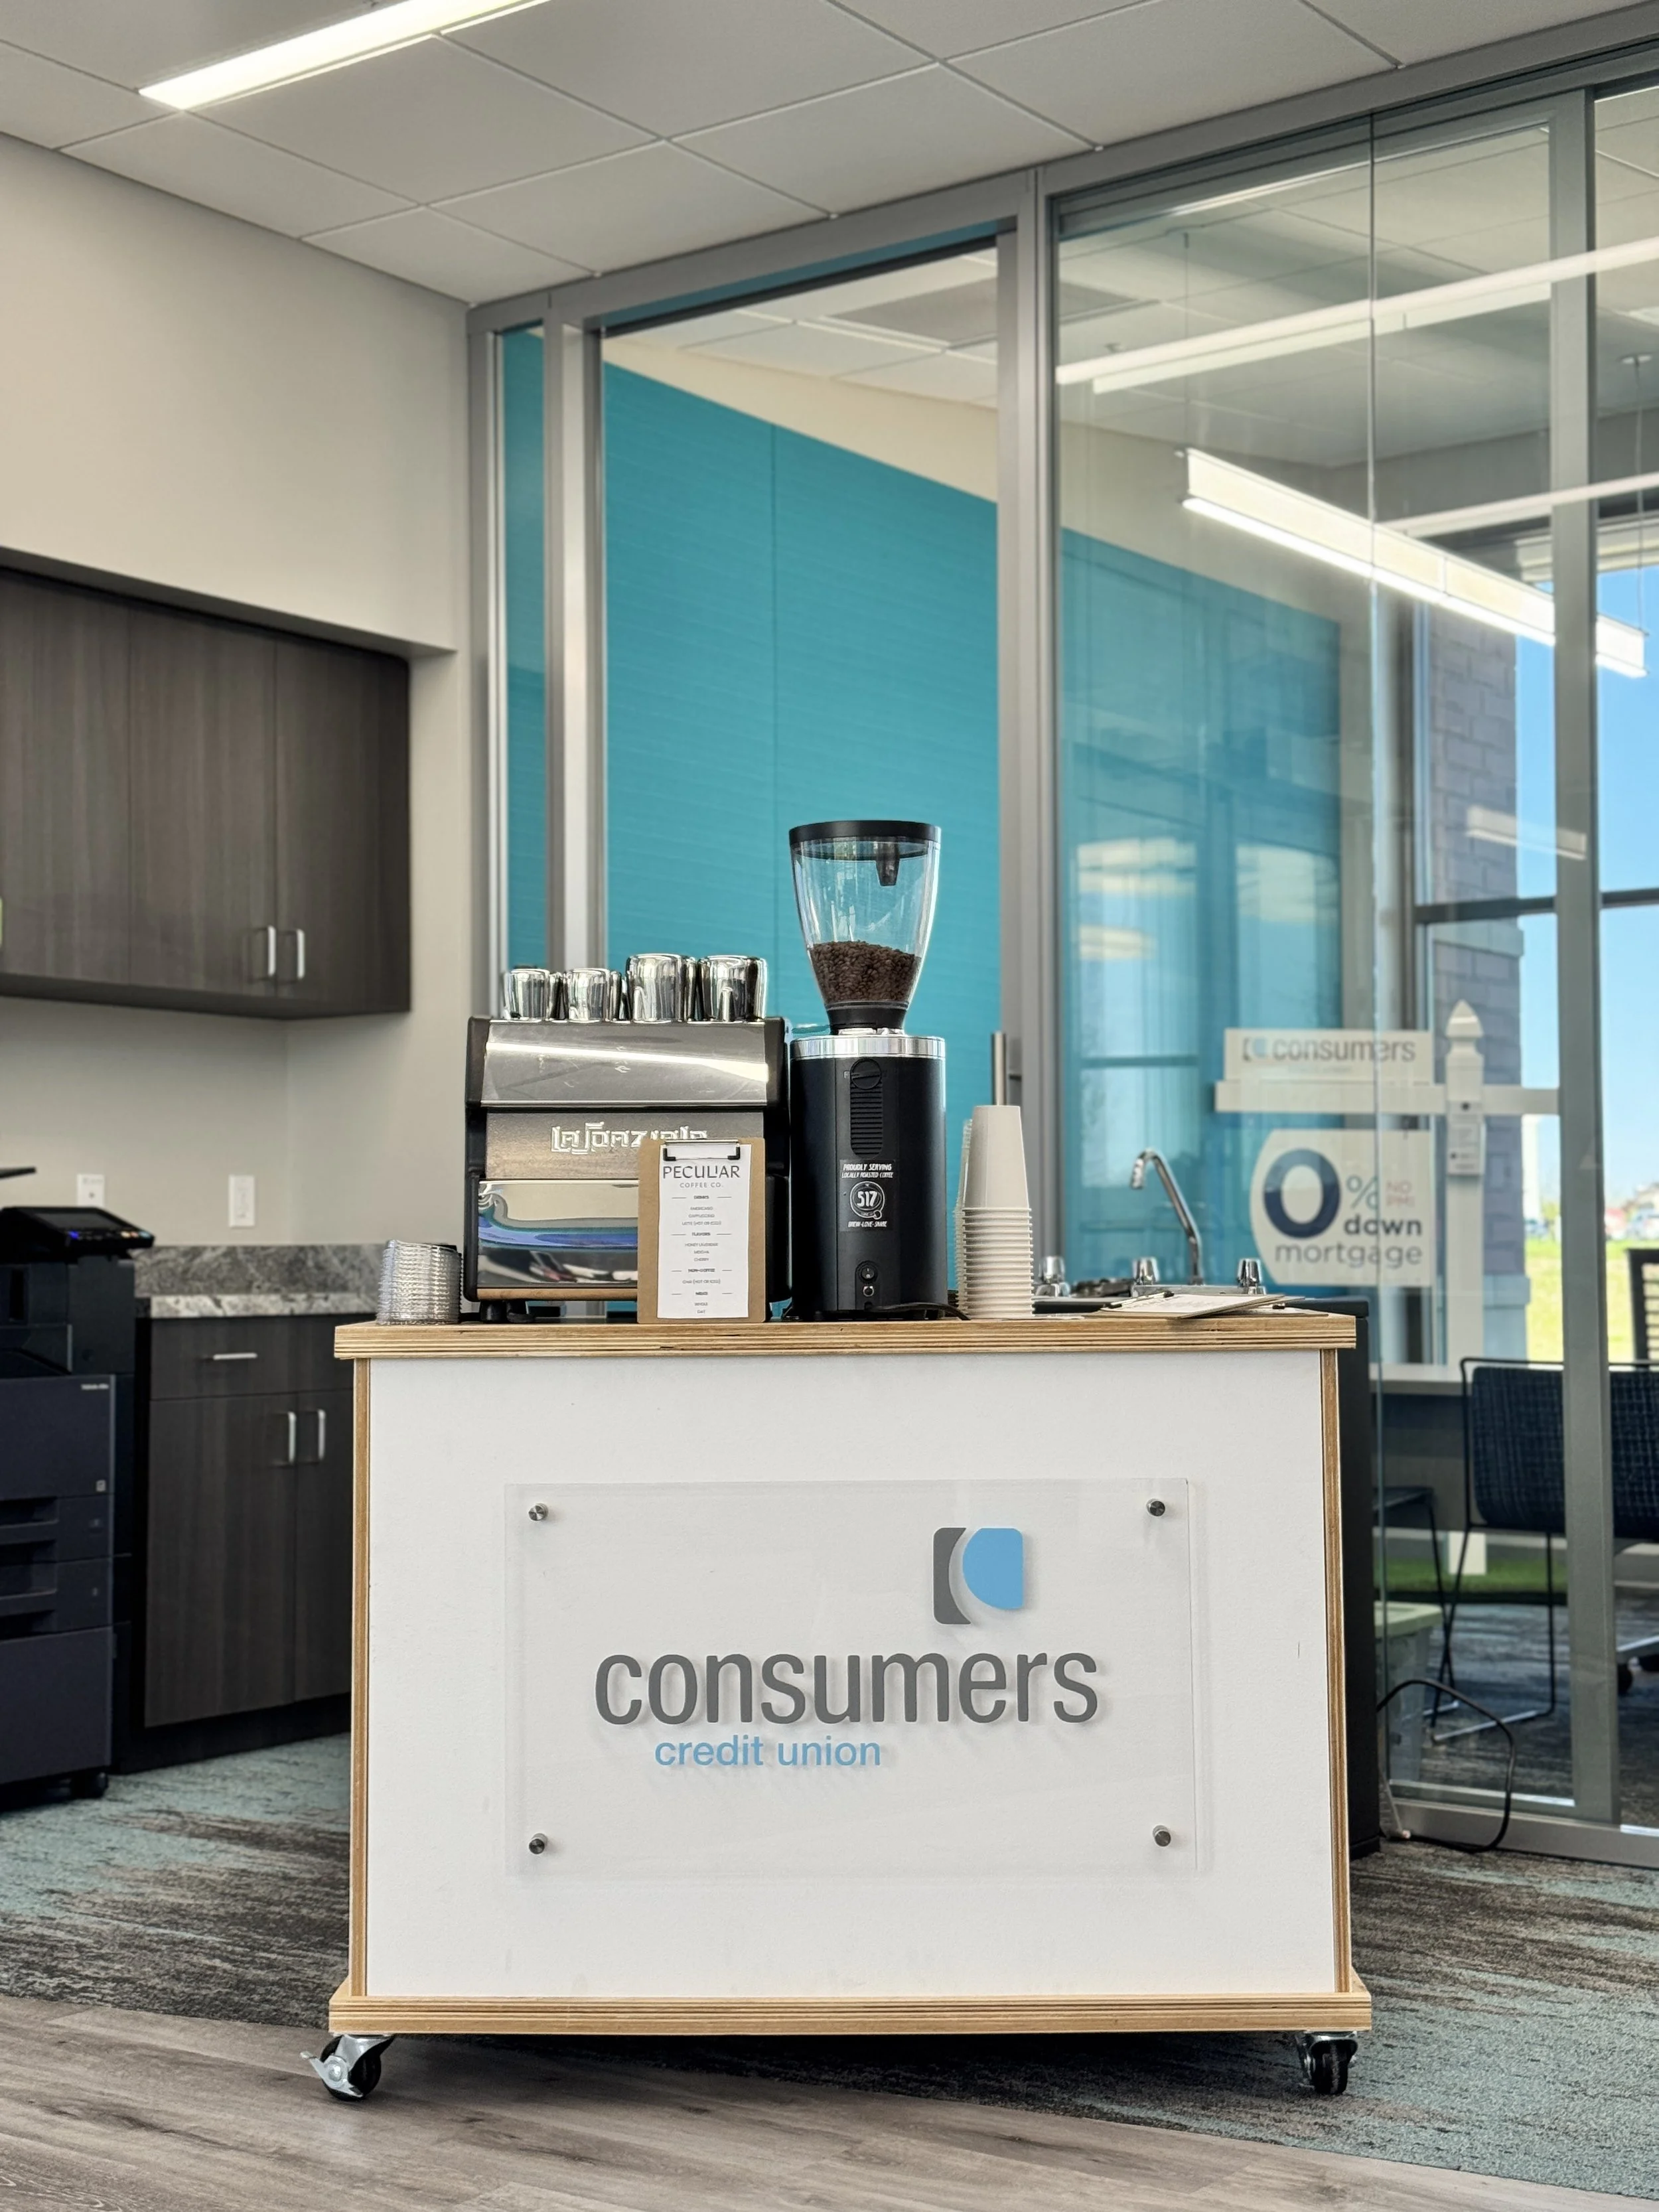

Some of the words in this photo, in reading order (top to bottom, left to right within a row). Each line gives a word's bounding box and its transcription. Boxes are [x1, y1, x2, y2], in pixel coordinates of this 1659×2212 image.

[1272, 1038, 1416, 1062] consumers
[662, 1165, 741, 1179] PECULIAR
[857, 1191, 877, 1207] 517
[1342, 1214, 1422, 1236] down
[1275, 1242, 1423, 1270] mortgage
[595, 1652, 1098, 1726] consumers
[654, 1735, 764, 1767] credit
[777, 1735, 881, 1766] union
